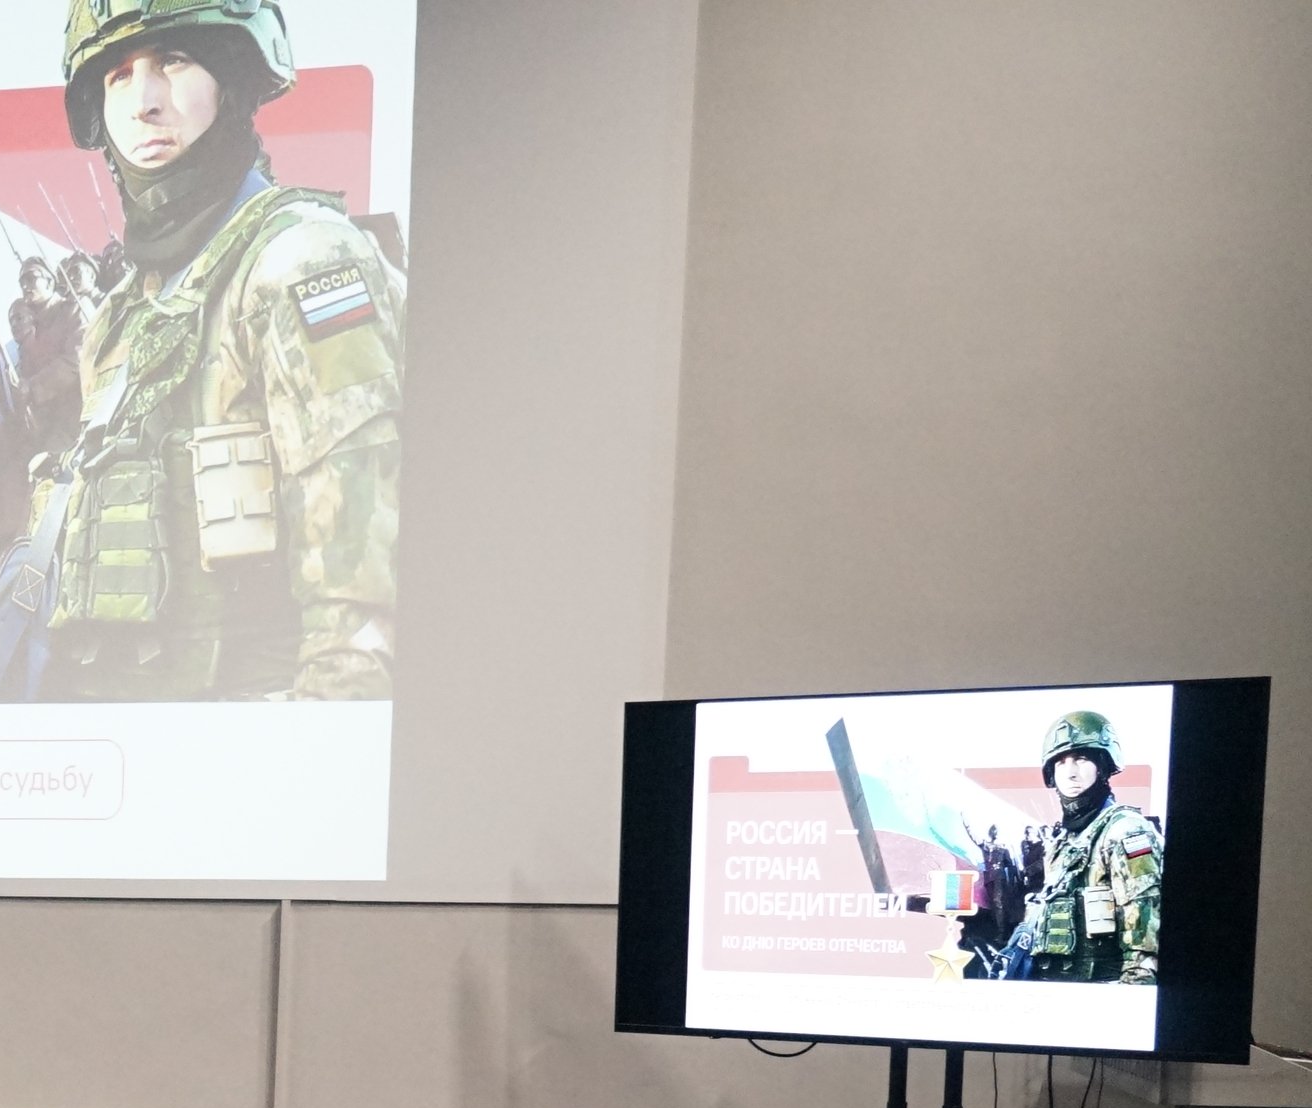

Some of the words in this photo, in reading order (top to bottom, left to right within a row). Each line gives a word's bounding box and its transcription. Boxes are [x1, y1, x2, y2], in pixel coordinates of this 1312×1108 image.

[295, 267, 361, 299] РОССИЯ
[0, 764, 94, 798] судьбу
[726, 820, 827, 845] РОССИЯ
[725, 856, 821, 881] СТРАНА
[722, 936, 740, 949] КО
[741, 936, 774, 951] ДНЮ
[777, 937, 826, 951] ГЕРОЕВ
[829, 938, 907, 954] ОТЕЧЕСТВА
